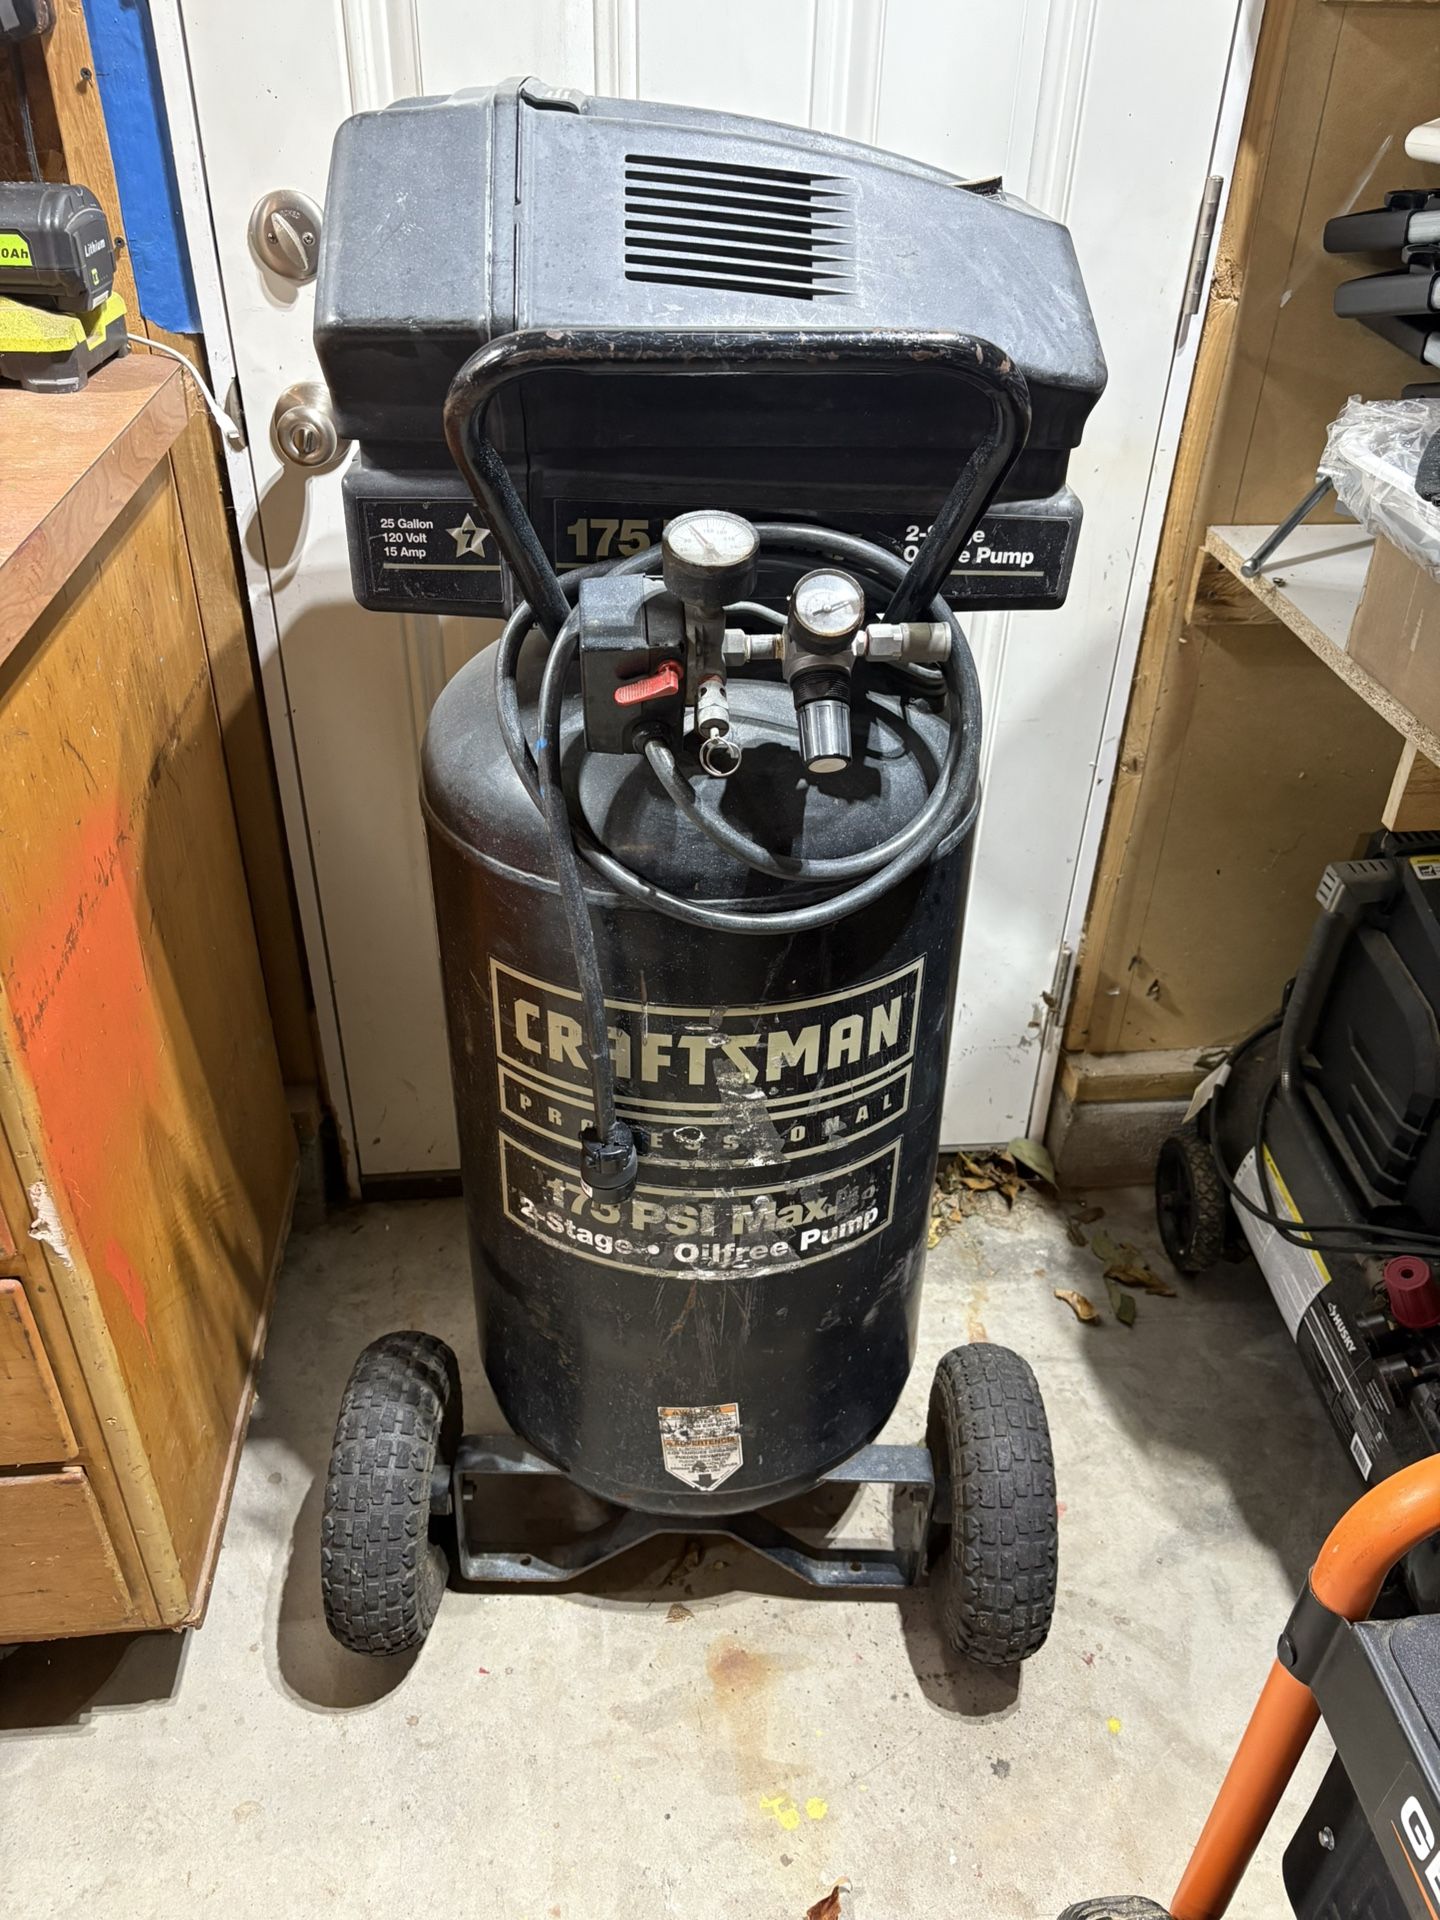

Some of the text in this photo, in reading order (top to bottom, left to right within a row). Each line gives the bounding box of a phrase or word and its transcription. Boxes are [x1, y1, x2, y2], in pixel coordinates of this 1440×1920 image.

[84, 238, 106, 258] Lithium
[380, 518, 434, 530] 25 Gallon
[382, 532, 428, 544] 120 Volt
[461, 529, 476, 549] 7
[567, 518, 651, 557] 175
[384, 546, 427, 560] 15 Amp
[976, 546, 1035, 568] Pump
[514, 995, 903, 1086] CRAFTSMAN
[673, 1240, 790, 1269] Oilfree
[800, 1206, 879, 1252] Pump
[1333, 1313, 1358, 1353] HUSKY
